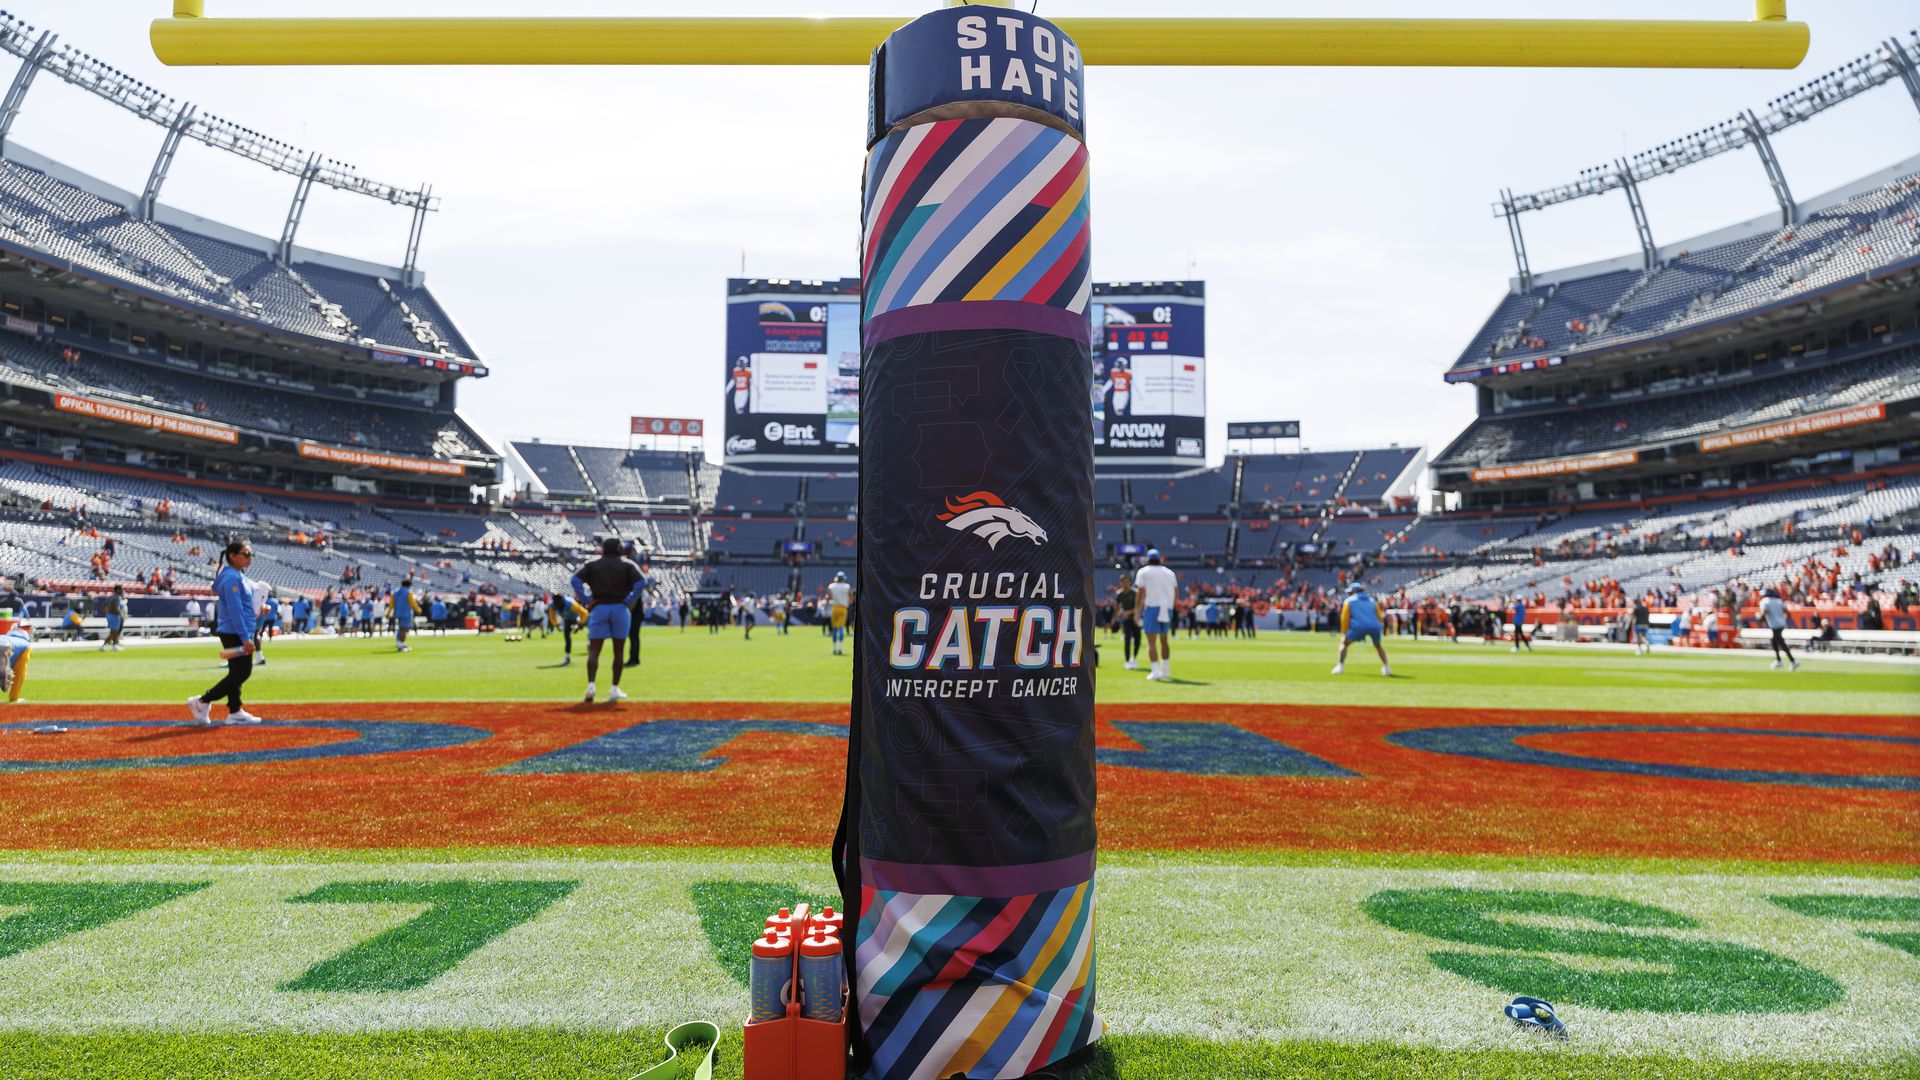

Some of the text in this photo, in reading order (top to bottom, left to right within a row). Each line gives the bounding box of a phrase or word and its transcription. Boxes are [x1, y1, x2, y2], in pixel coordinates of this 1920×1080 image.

[957, 16, 1080, 74] STOP
[961, 55, 1080, 120] HATE
[60, 397, 95, 413] OFFICIAL
[96, 404, 125, 419] TRUCKS
[133, 412, 152, 425] SUVS
[153, 416, 163, 427] OF
[164, 418, 177, 429] THE
[178, 421, 205, 435] DENVER
[206, 427, 236, 441] BRONCOS
[783, 425, 815, 440] Ent
[303, 445, 330, 456] OFFICIAL
[331, 450, 355, 461] TRUCKS
[919, 572, 1065, 600] CRUCIAL
[890, 605, 1084, 670] CATCH
[886, 676, 1078, 699] INTERCEPT CANCER
